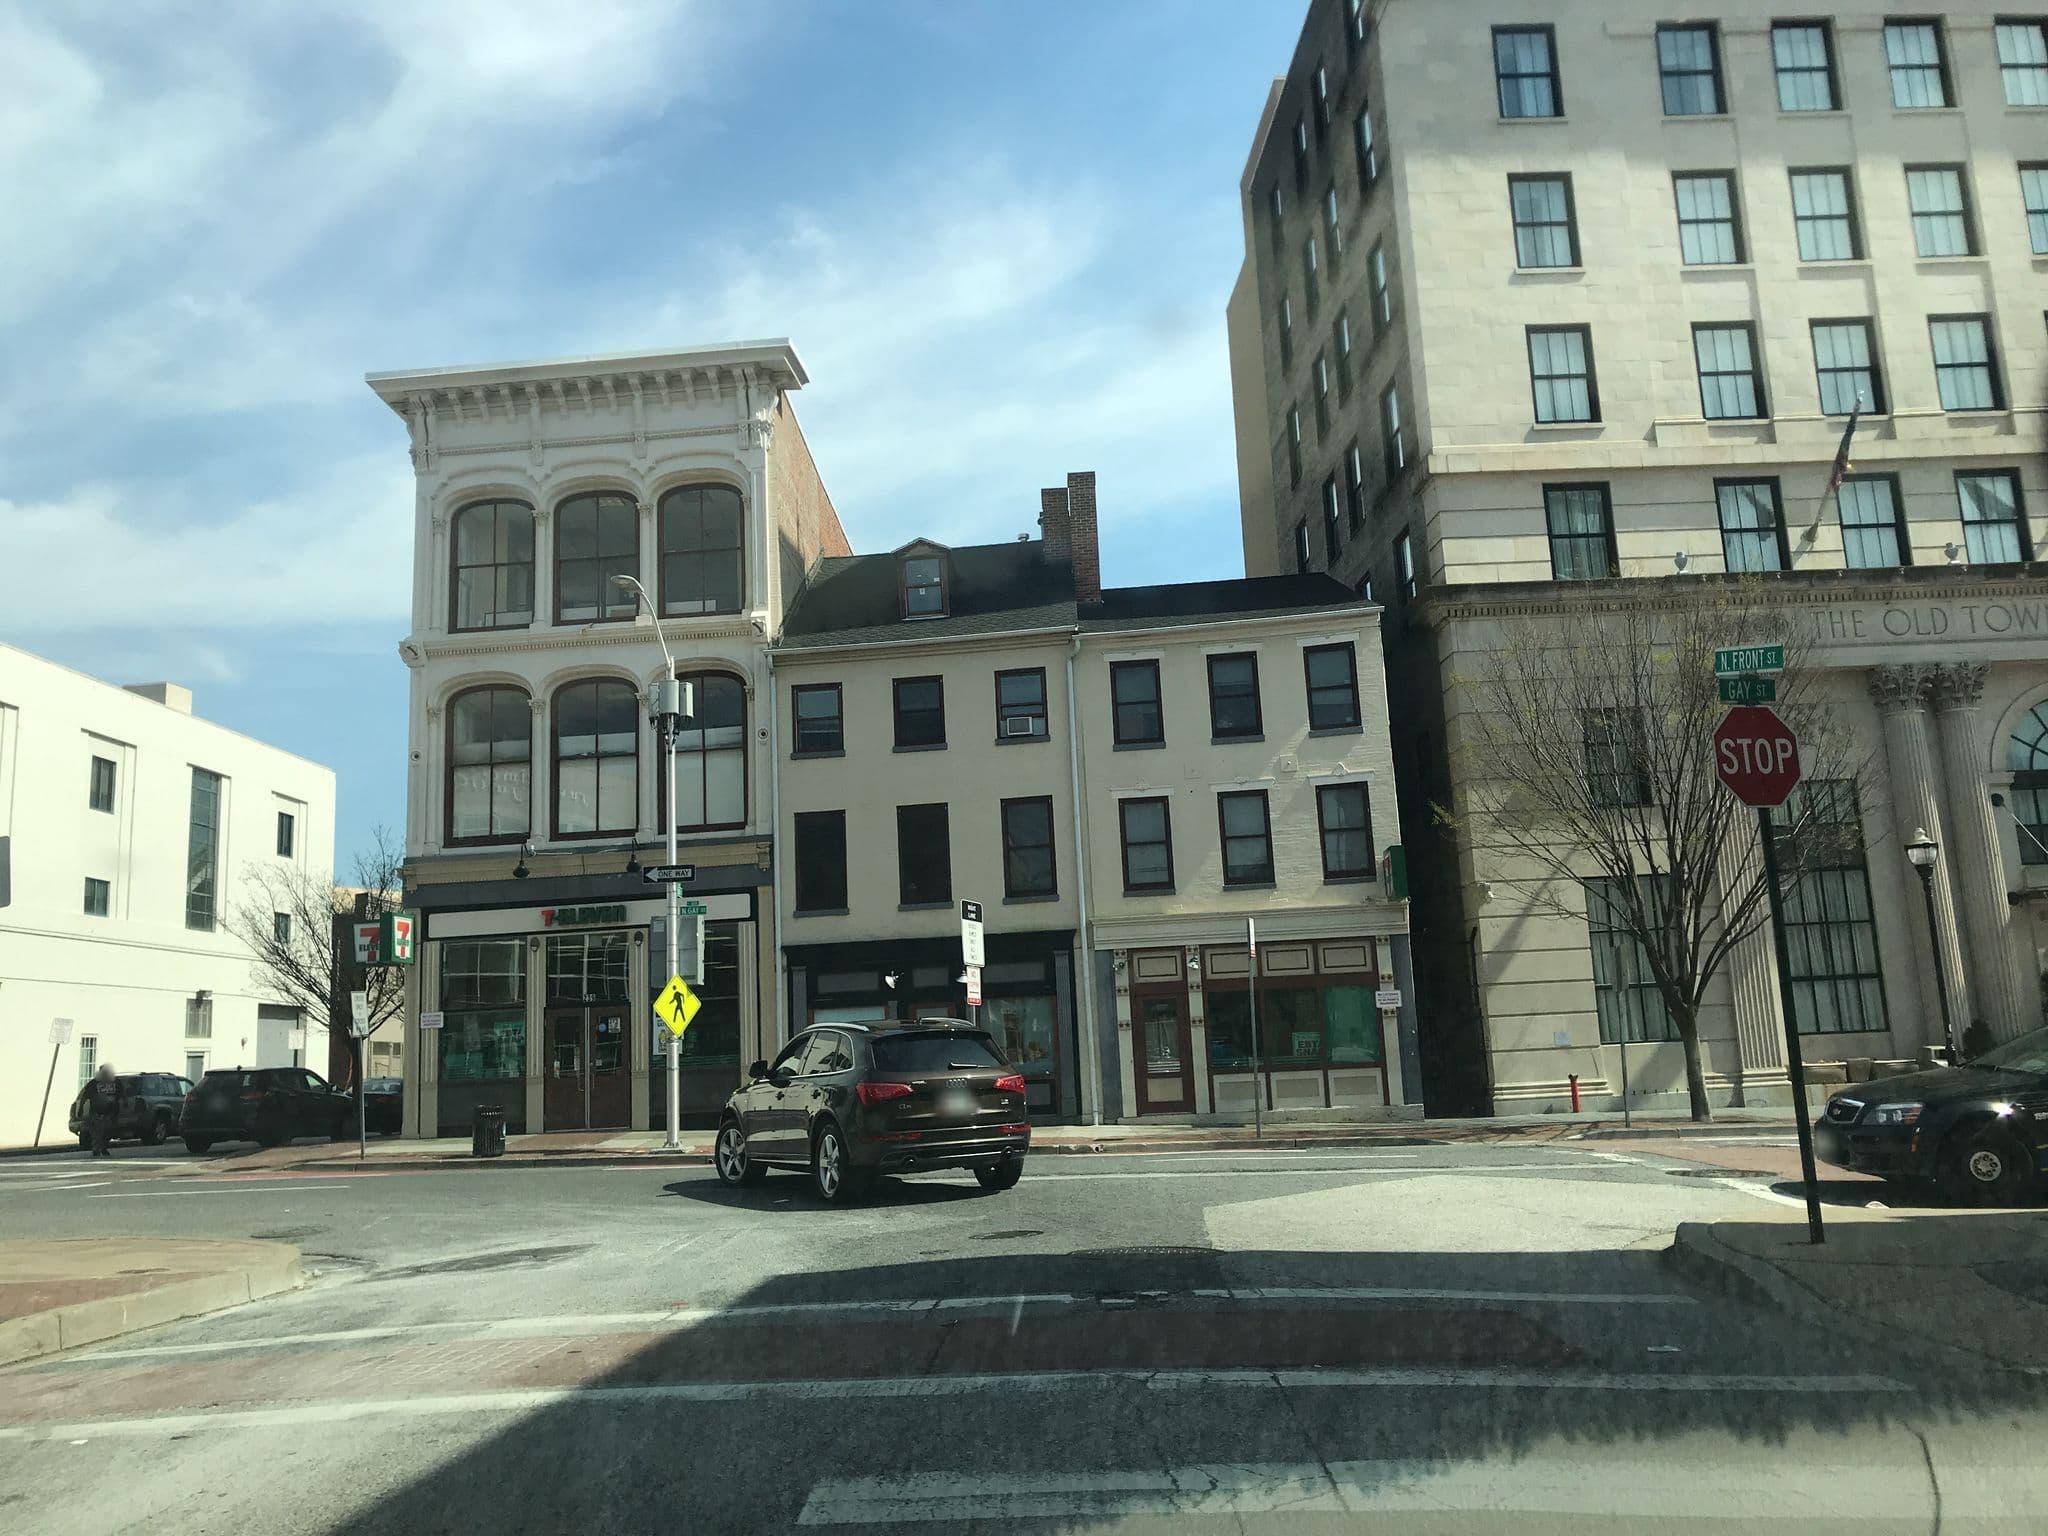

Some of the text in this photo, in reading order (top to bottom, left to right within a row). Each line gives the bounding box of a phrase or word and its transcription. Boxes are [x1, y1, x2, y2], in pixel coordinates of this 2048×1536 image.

[1809, 609, 1866, 639] THE
[1882, 607, 1948, 636] OLD
[1720, 652, 1731, 671] N.
[1732, 649, 1765, 671] FRONT
[1728, 681, 1767, 700] GAY ST
[1720, 738, 1793, 775] STOP
[675, 869, 690, 877] WAY
[397, 921, 409, 958] 7
